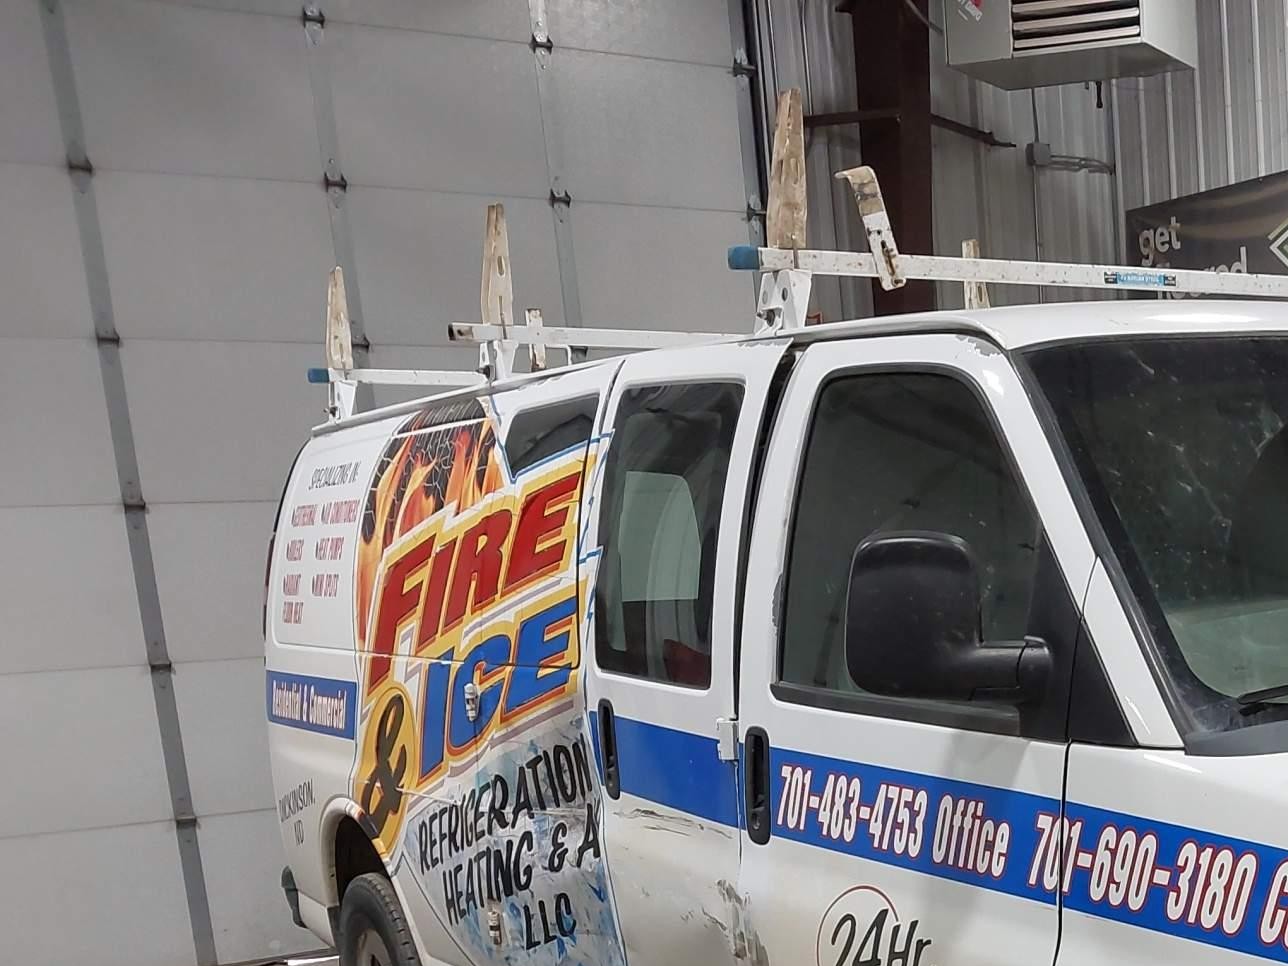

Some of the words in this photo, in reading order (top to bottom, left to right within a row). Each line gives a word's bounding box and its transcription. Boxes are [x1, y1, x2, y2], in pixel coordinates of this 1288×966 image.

[1139, 216, 1181, 266] get
[368, 471, 583, 692] FIRE
[272, 680, 302, 721] Residential
[302, 683, 308, 722] &
[309, 685, 347, 729] Commercial
[361, 694, 408, 836] &
[417, 595, 578, 783] ICE
[418, 732, 593, 875] REFRIGERATION
[776, 764, 929, 858] 701-483-4753
[932, 794, 1010, 877] Office
[1027, 813, 1258, 936] 701-690-3180
[442, 831, 534, 926] HEATING
[548, 822, 569, 873] &
[523, 892, 577, 950] LLC
